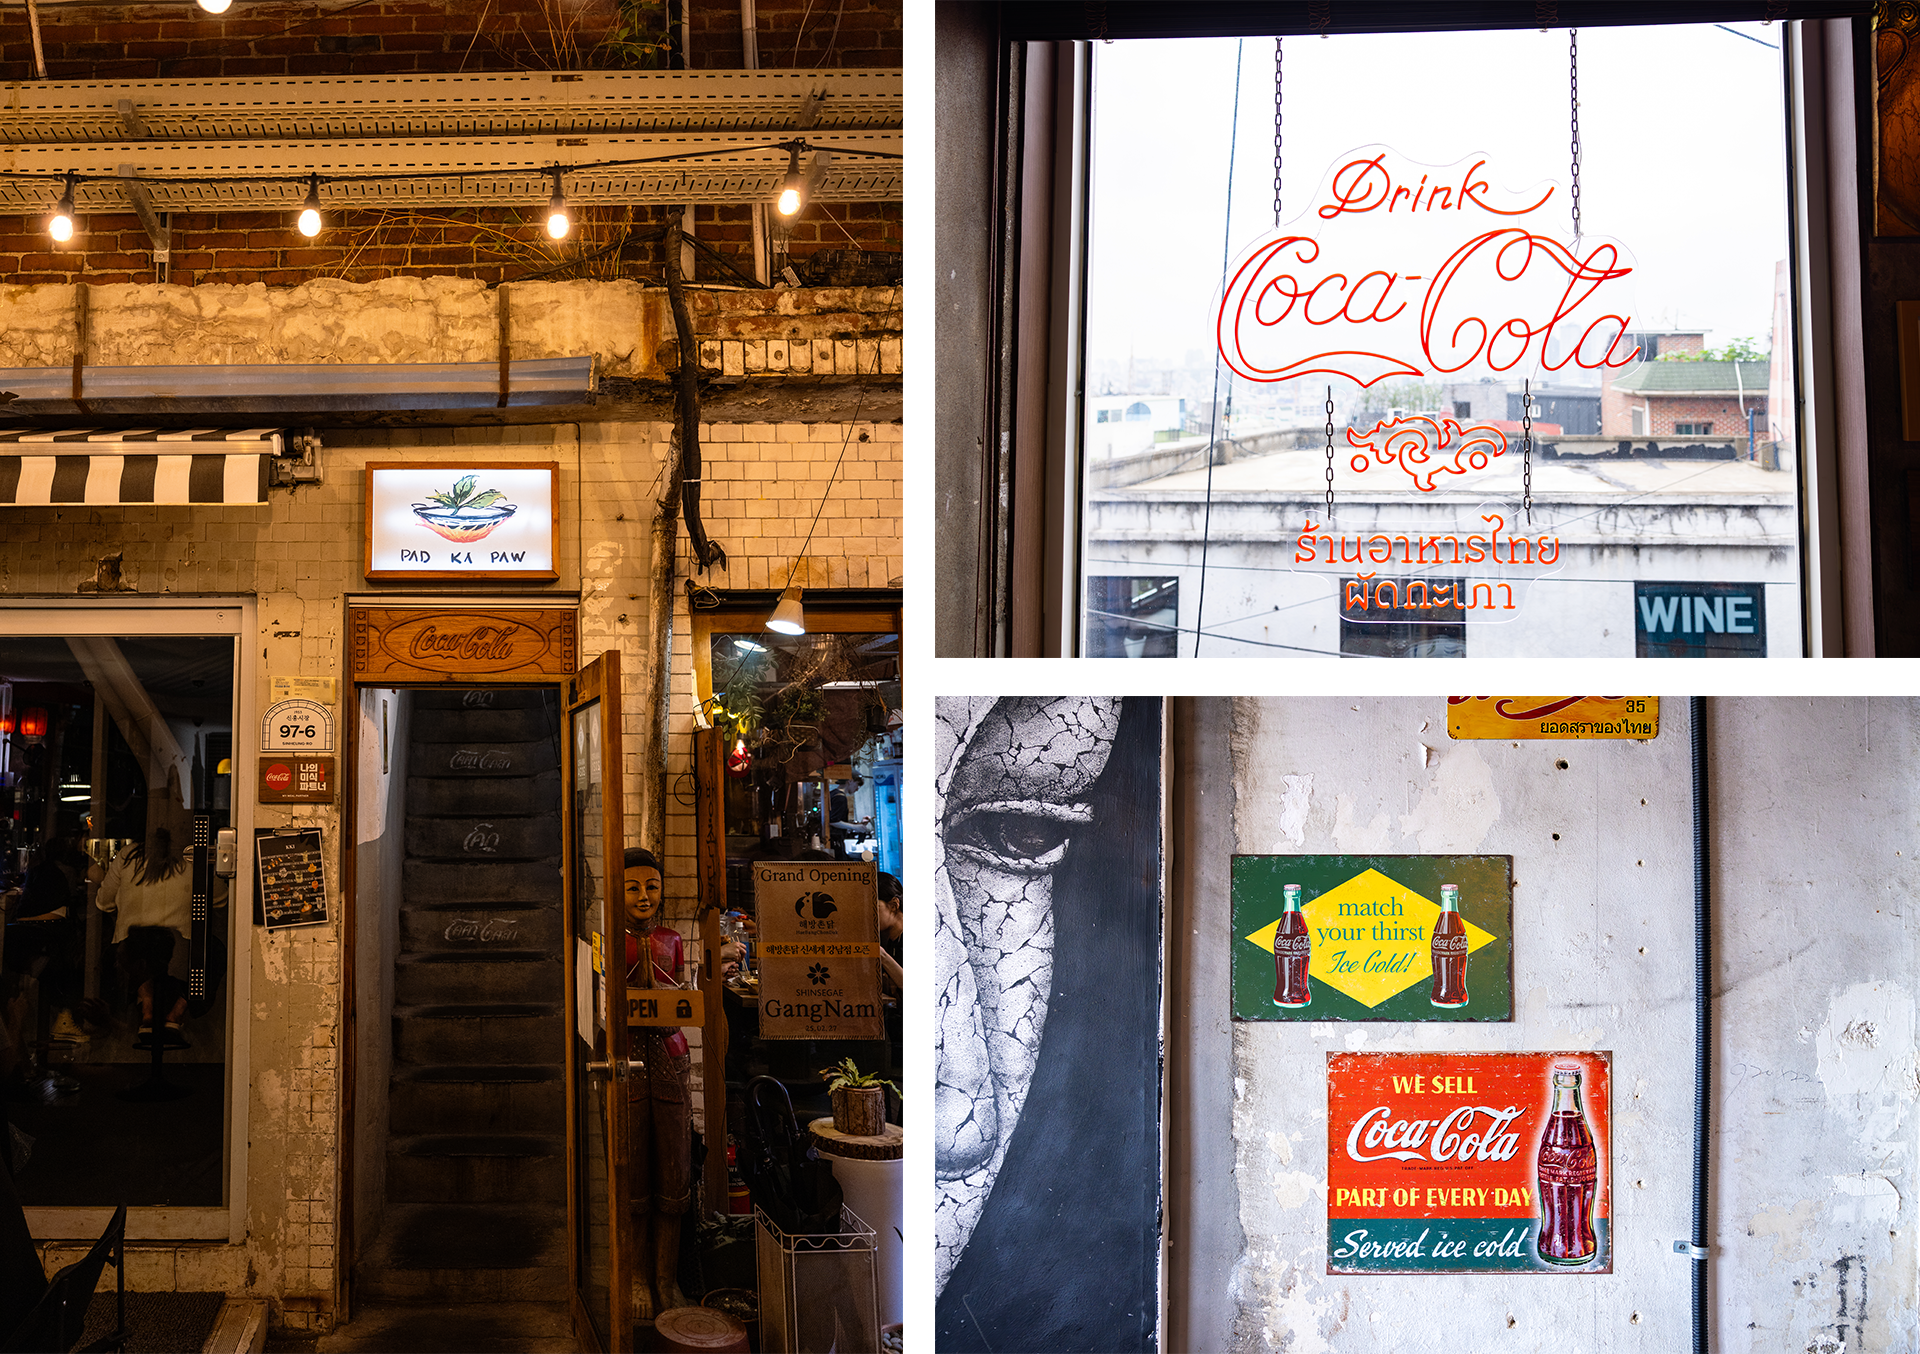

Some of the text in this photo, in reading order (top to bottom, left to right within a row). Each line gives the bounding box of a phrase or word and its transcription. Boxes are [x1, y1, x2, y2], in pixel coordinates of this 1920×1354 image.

[1318, 152, 1554, 220] Drink
[1216, 228, 1642, 389] Coca-Cola
[1294, 514, 1560, 565] ร้านอาหารไทย
[400, 549, 527, 564] PAD KA PAW
[1639, 596, 1755, 635] WINE
[410, 625, 520, 661] Coca-Cola
[1625, 700, 1646, 713] 35
[280, 724, 316, 739] 97-6
[1540, 718, 1653, 739] ยอดสุราของไทย
[300, 763, 318, 772] 나의
[300, 772, 318, 782] 미식
[299, 782, 327, 791] 파트너
[760, 868, 871, 885] Grand Opening
[1338, 896, 1404, 917] match
[1316, 921, 1426, 947] your thirst
[765, 944, 871, 955] 해방촌닭 신세계 강남점 오픈
[1326, 950, 1417, 974] Ice Cold!
[796, 989, 843, 997] SHINSEGAE
[765, 999, 876, 1023] GangNam
[1393, 1076, 1478, 1094] WE SELL
[1346, 1105, 1528, 1163] Coca-Cola
[1335, 1188, 1534, 1207] PART OF EVERY DAY
[1333, 1227, 1528, 1259] Served ice cold
